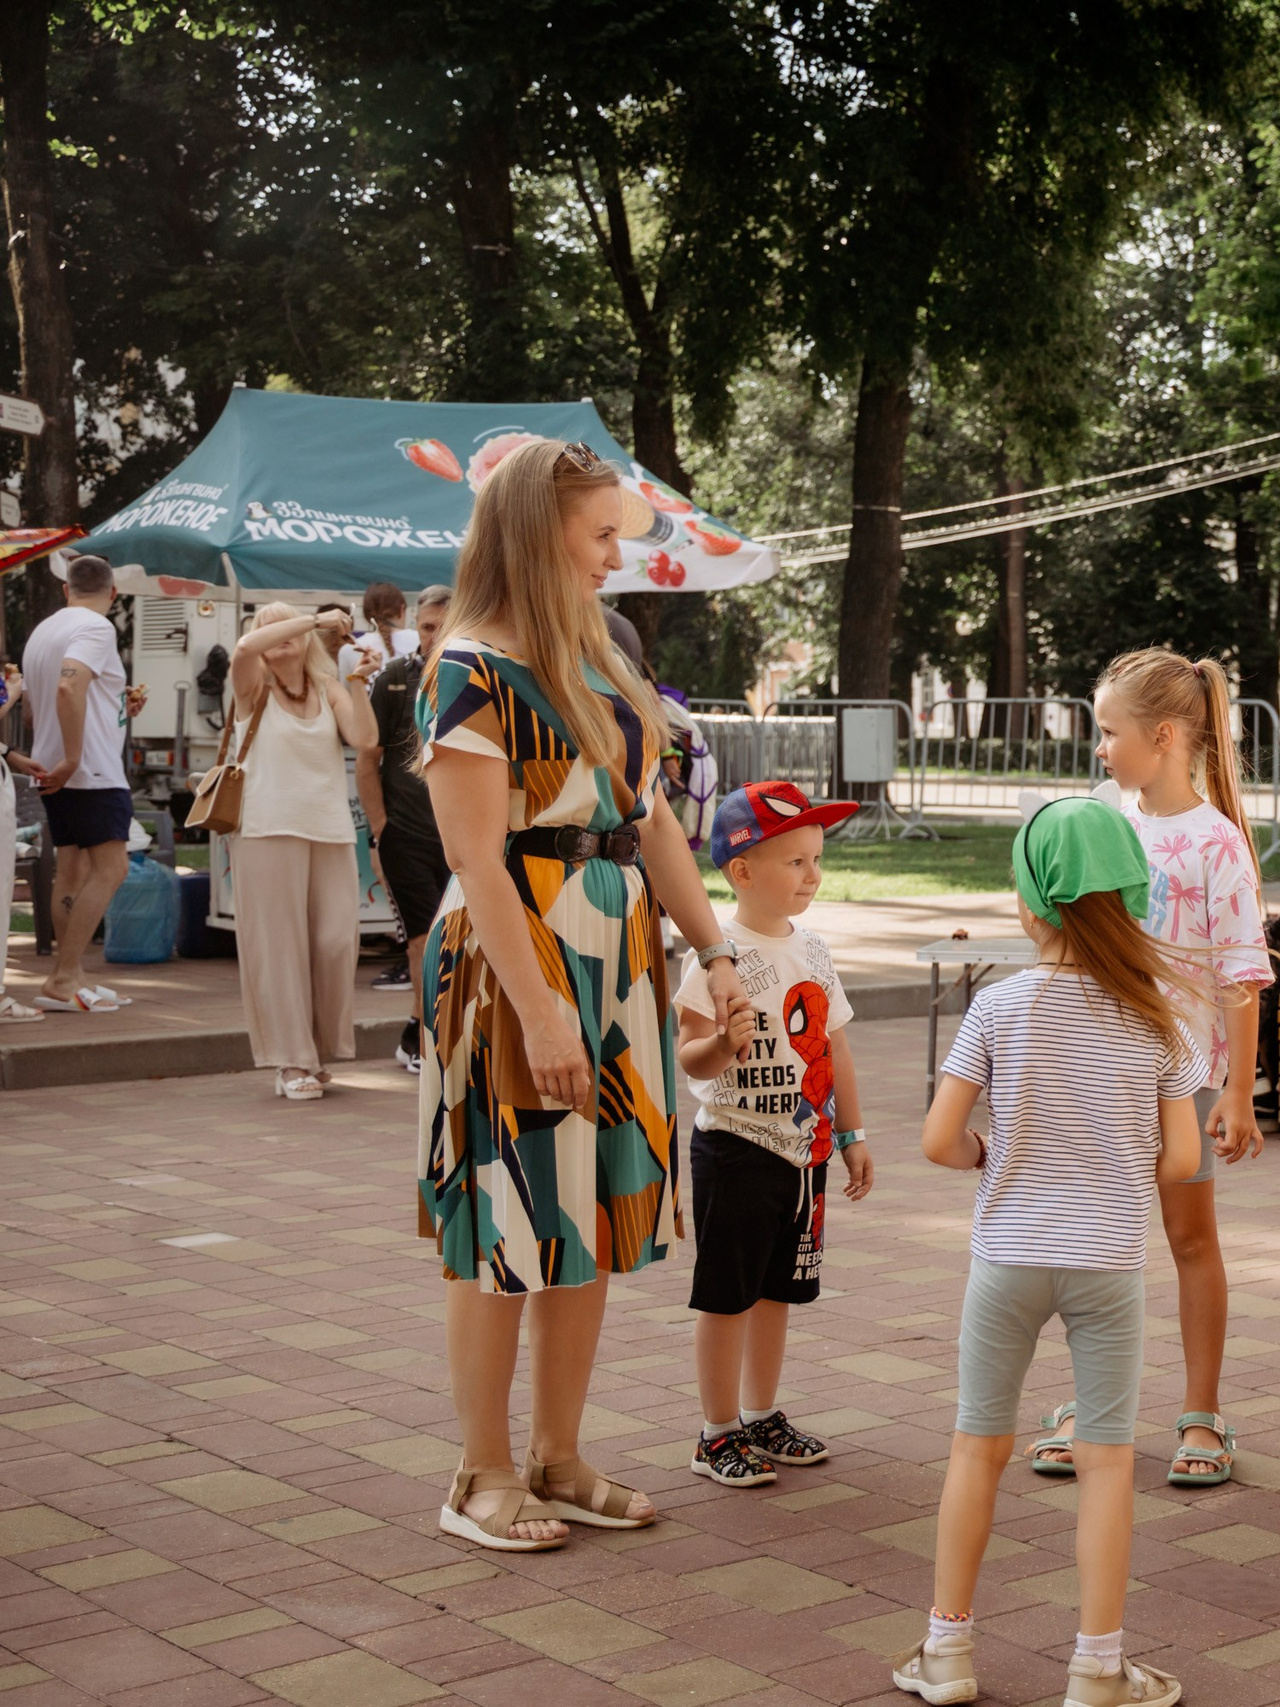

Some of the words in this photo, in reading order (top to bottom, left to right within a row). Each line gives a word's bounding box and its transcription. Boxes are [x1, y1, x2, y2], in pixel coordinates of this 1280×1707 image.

[95, 500, 229, 536] МОРОЖЕНОЕ
[244, 518, 467, 548] МОРОЖЕН
[730, 829, 751, 847] MARVEL
[740, 964, 780, 999] CITY
[737, 1064, 796, 1089] NEEDS
[737, 1096, 749, 1110] A
[801, 1234, 811, 1242] THE
[798, 1243, 812, 1252] CITY
[792, 1267, 802, 1280] A
